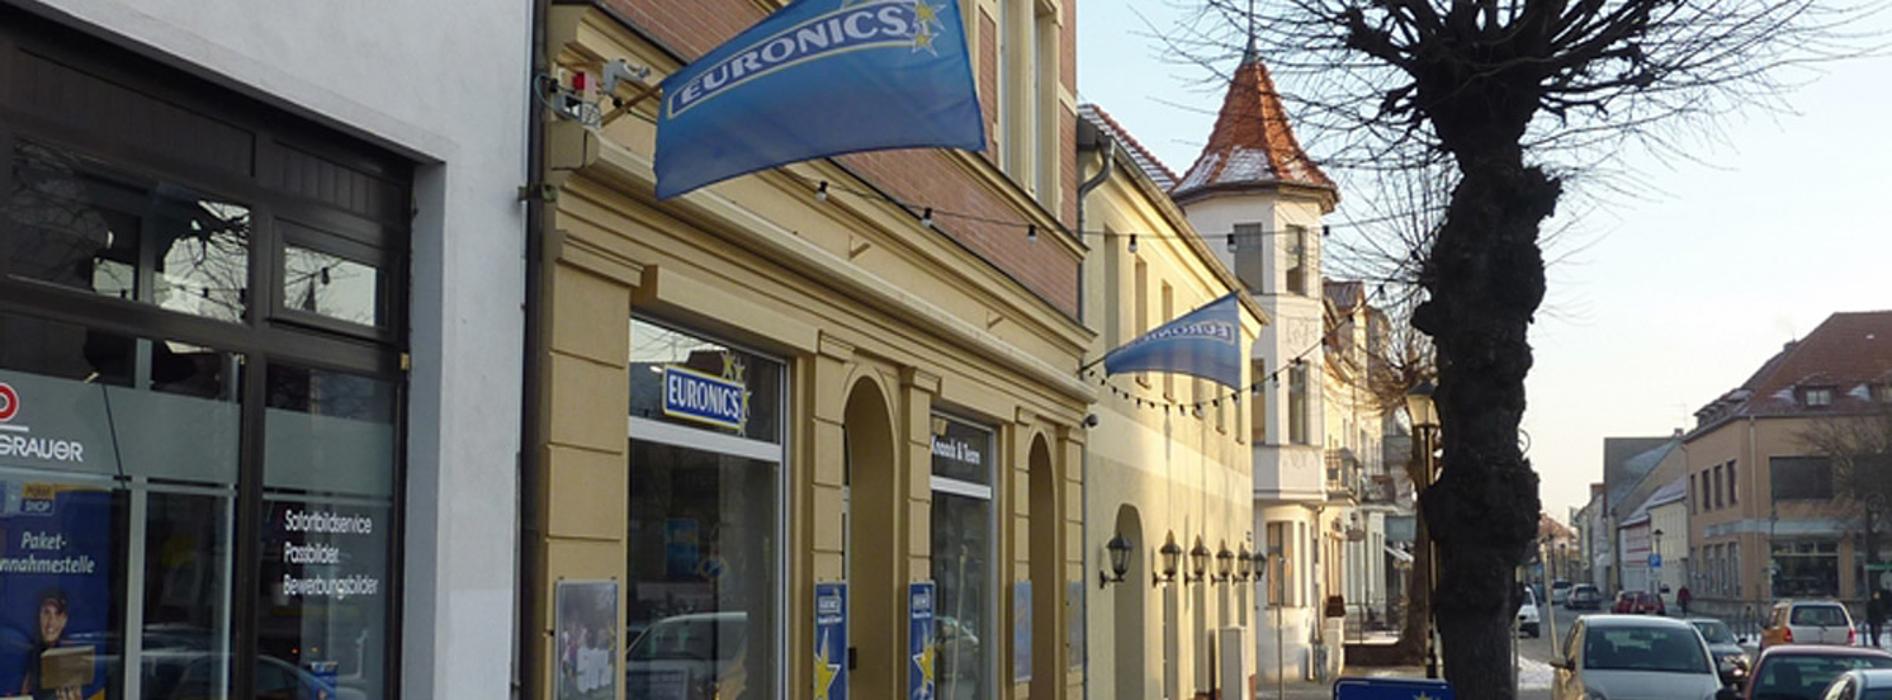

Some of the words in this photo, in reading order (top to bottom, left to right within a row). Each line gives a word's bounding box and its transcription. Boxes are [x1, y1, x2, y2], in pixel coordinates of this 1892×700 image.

[680, 5, 907, 105] EURONICS
[668, 374, 739, 419] EURONICS
[963, 443, 980, 465] Team
[285, 509, 372, 534] Sofortbildservice
[21, 531, 67, 550] Paket-
[283, 574, 379, 600] Bewerbungsbilder
